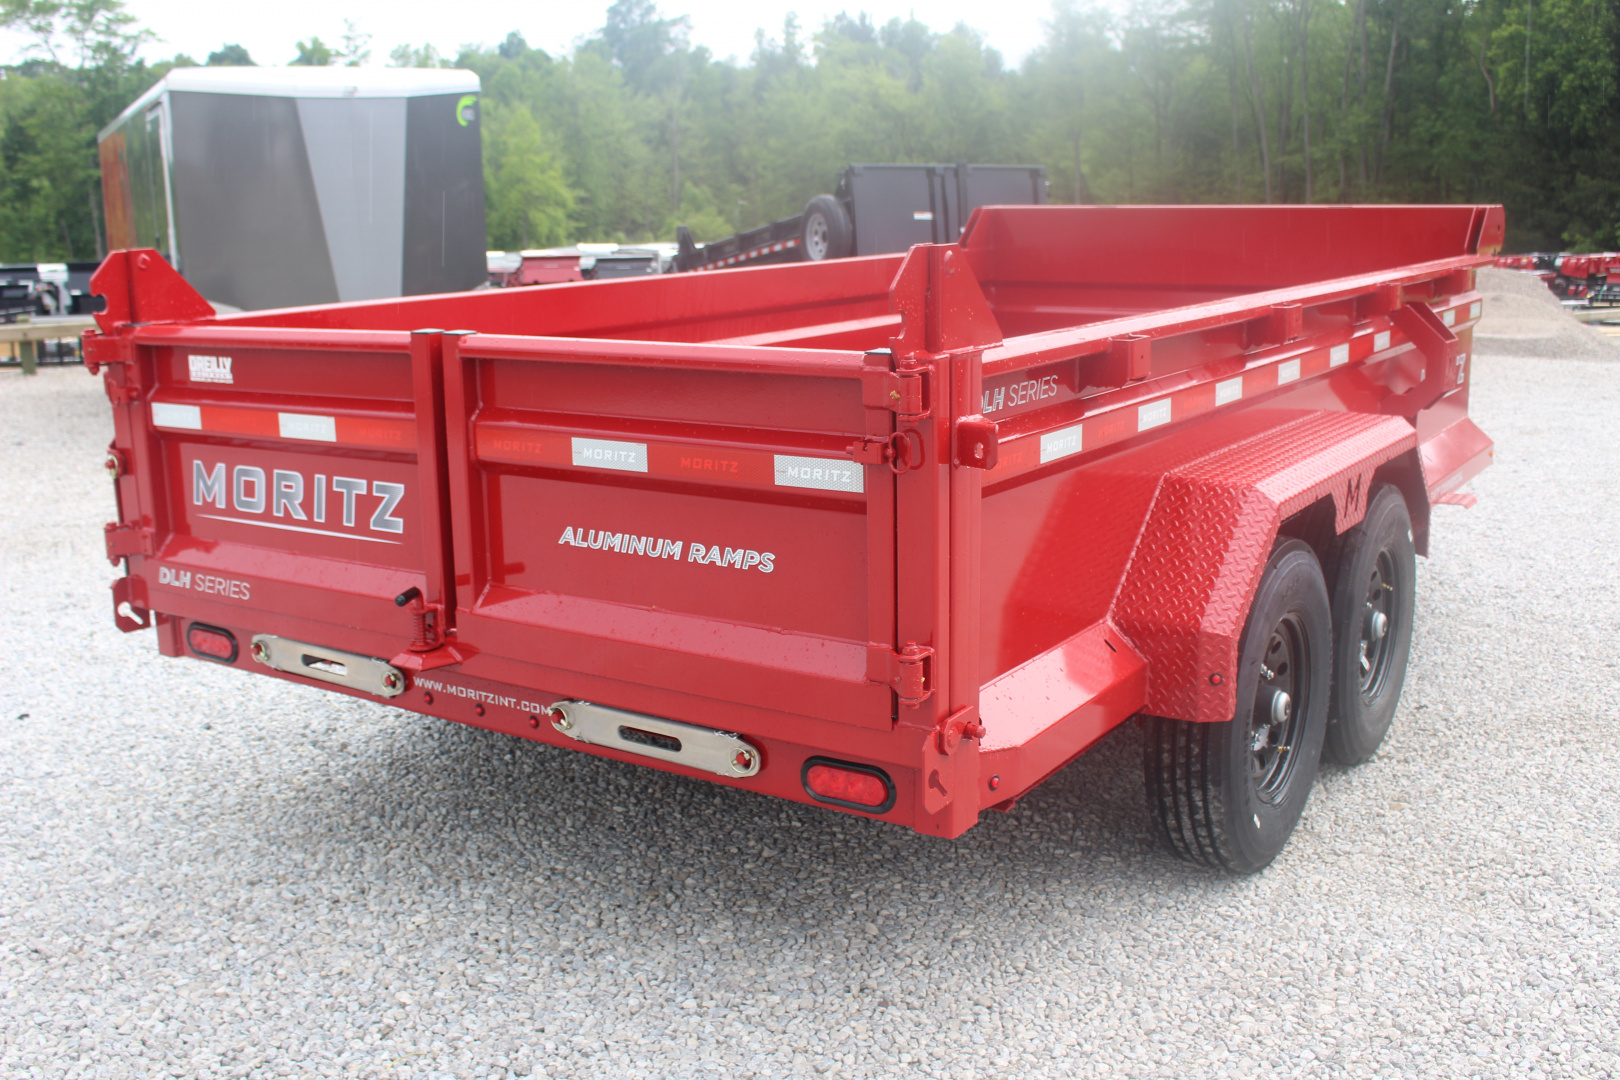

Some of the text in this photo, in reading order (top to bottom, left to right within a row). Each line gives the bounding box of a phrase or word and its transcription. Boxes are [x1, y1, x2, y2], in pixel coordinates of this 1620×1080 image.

[981, 375, 1058, 414] LH SERIES
[287, 420, 328, 434] MORITZ
[493, 440, 542, 454] MORITZ
[1046, 435, 1077, 453] MORITZ
[583, 448, 636, 463] MORITZ
[680, 457, 739, 472] MORITZ
[787, 466, 852, 483] MORITZ
[193, 459, 405, 534] MORITZ
[558, 526, 776, 573] ALUMINUM RAMPS
[159, 566, 251, 600] DLH SERIES
[413, 676, 551, 716] WWW.MORITZINT.COM
